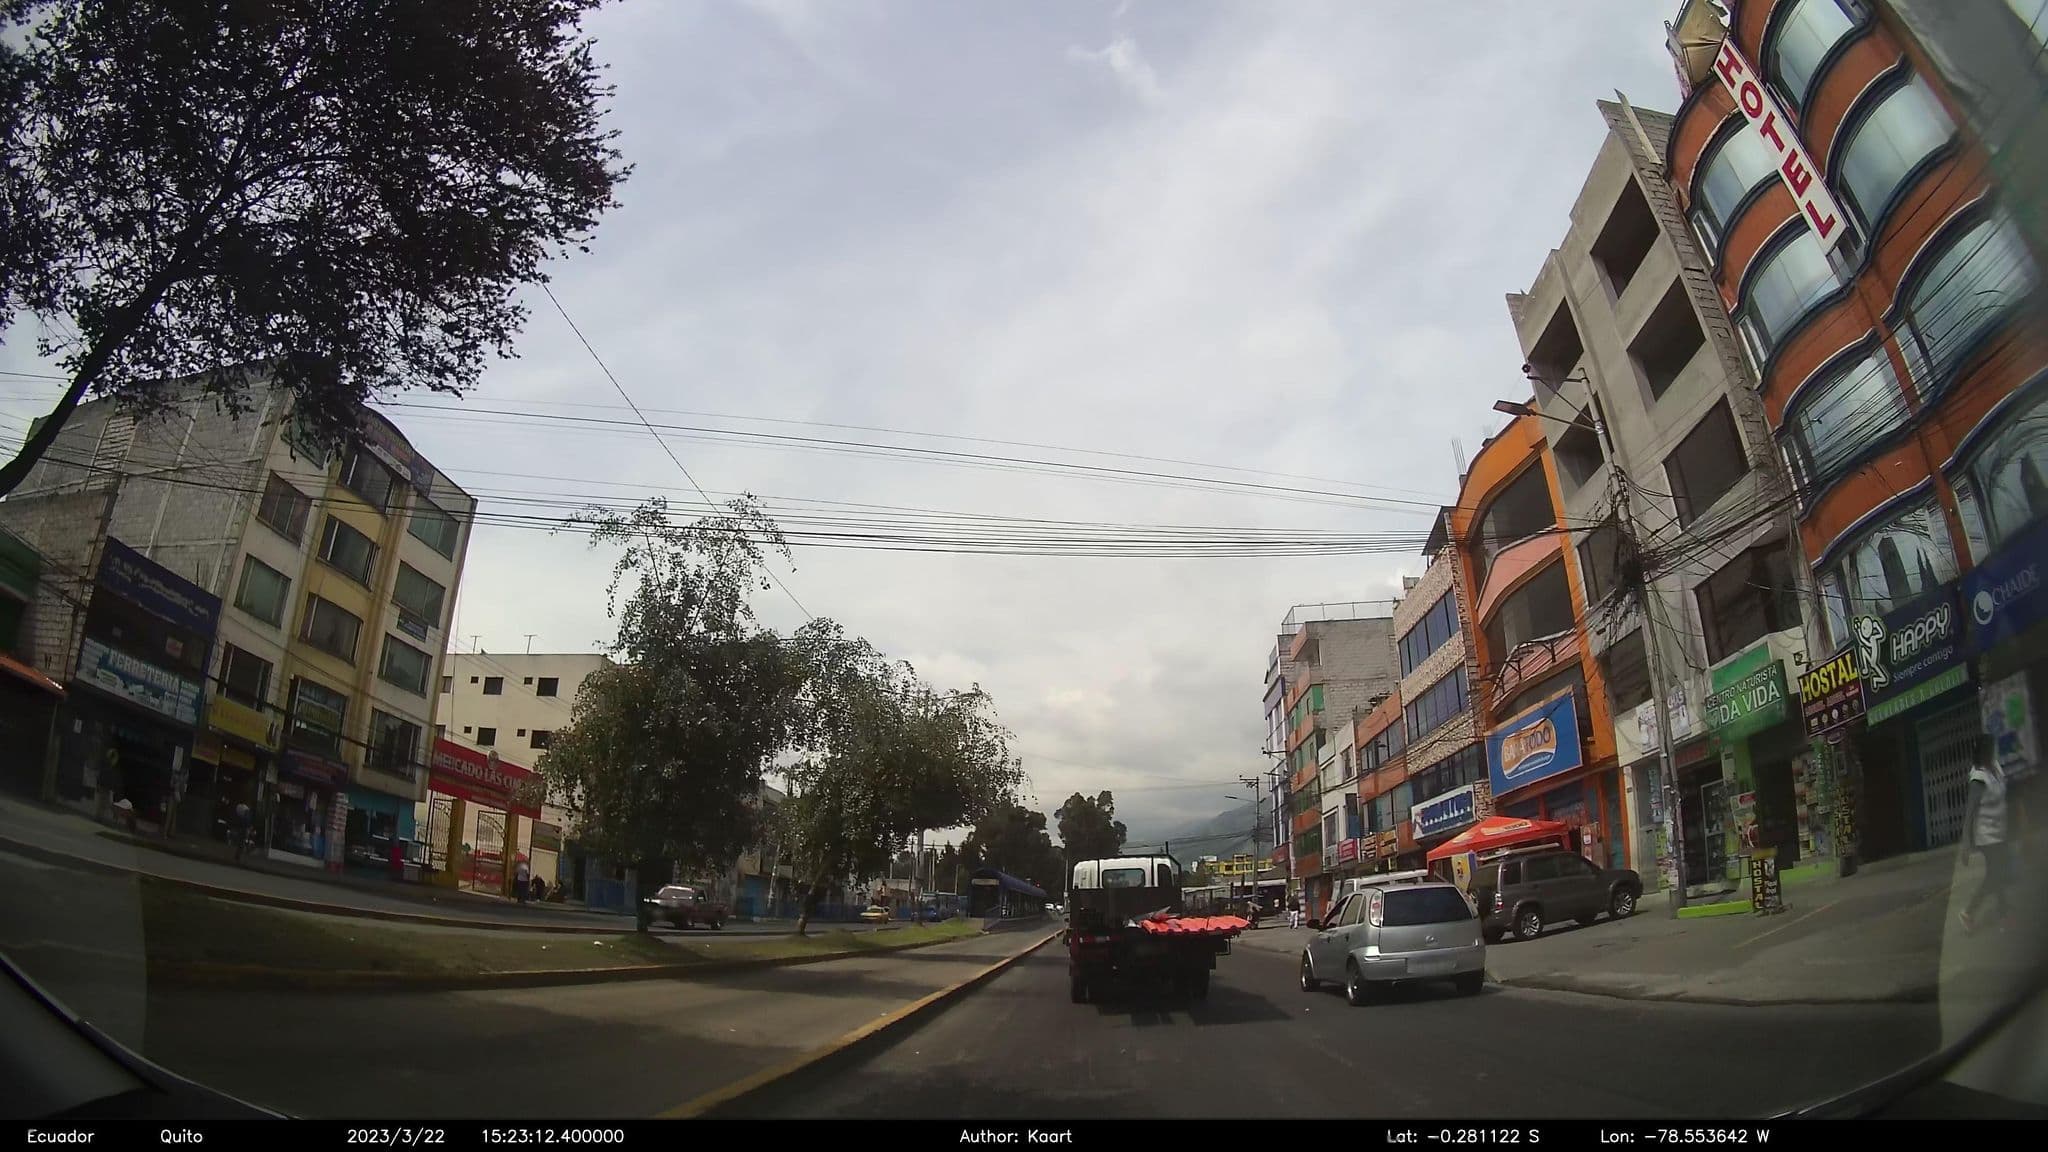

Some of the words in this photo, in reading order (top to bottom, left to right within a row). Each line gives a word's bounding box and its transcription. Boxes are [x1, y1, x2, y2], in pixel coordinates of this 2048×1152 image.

[1716, 44, 1836, 239] HOTEL
[1992, 565, 2039, 606] CHAIDE
[1892, 604, 1949, 662] HAPPY
[1800, 653, 1858, 703] HOSTAL
[1923, 646, 1953, 668] contigo
[1707, 686, 1735, 708] CENTRO
[1736, 664, 1778, 693] NATURISTA
[1720, 700, 1741, 724] DA
[1744, 680, 1781, 712] VIDA
[434, 752, 483, 779] MERCADO
[485, 769, 502, 785] LAS
[1752, 860, 1764, 909] HOSTAL
